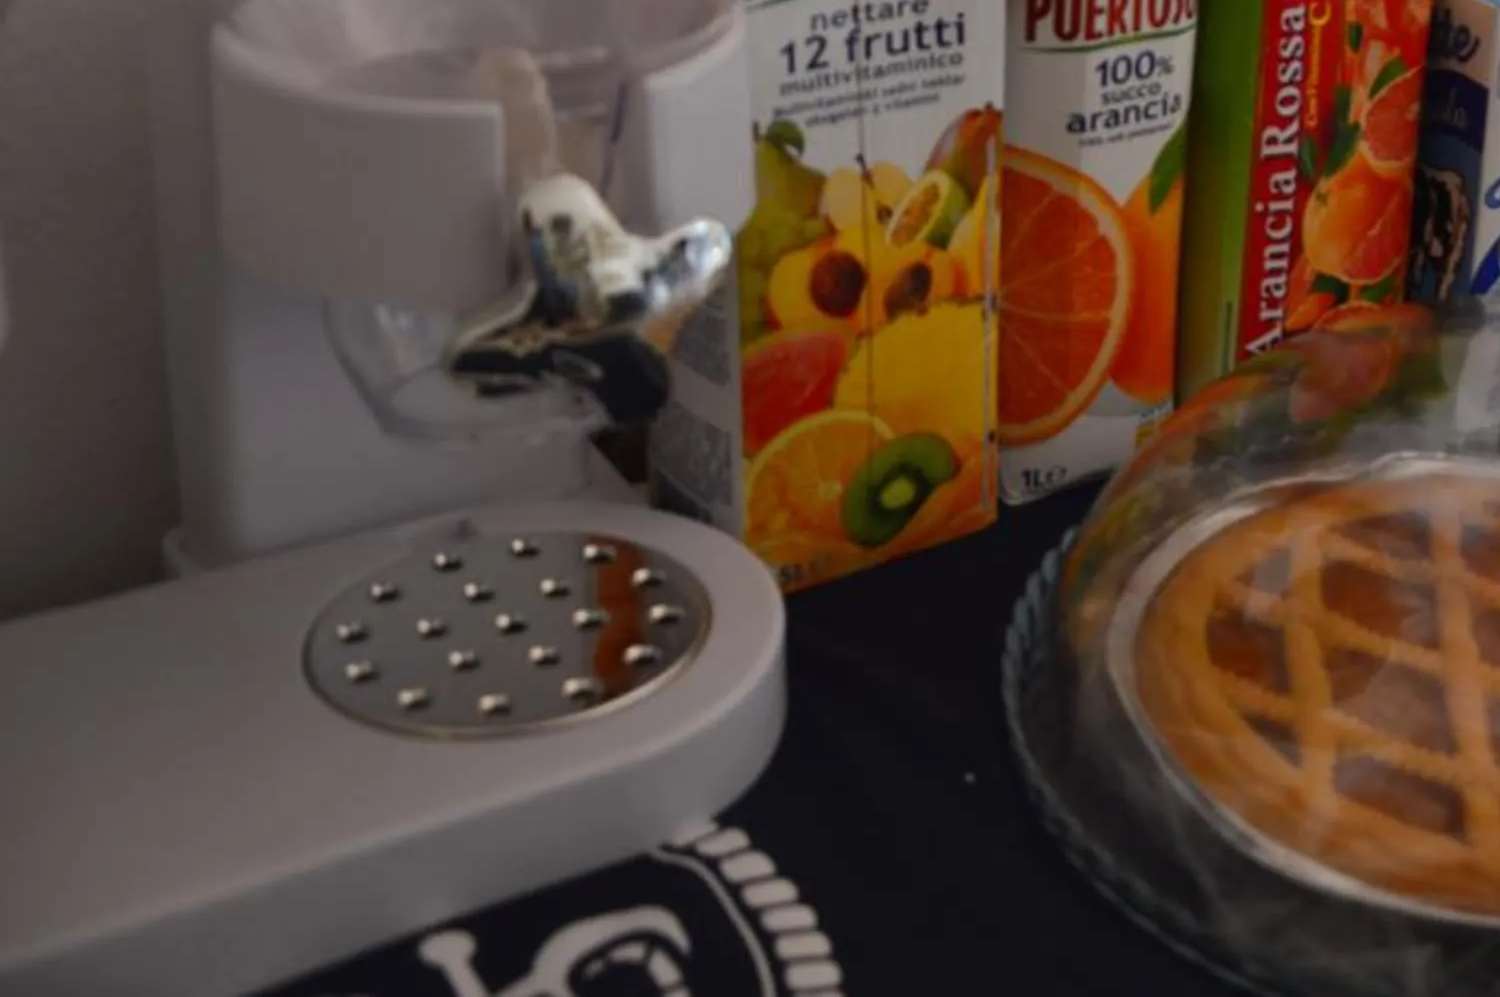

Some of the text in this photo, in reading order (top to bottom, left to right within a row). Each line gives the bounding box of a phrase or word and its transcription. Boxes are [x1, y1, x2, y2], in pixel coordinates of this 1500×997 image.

[780, 12, 965, 73] 12 frutti
[779, 51, 965, 97] multivitaminico
[1095, 50, 1174, 88] 100%
[1066, 91, 1182, 134] arancia
[1101, 82, 1162, 105] succo
[1245, 4, 1306, 353] Arancia Rossa
